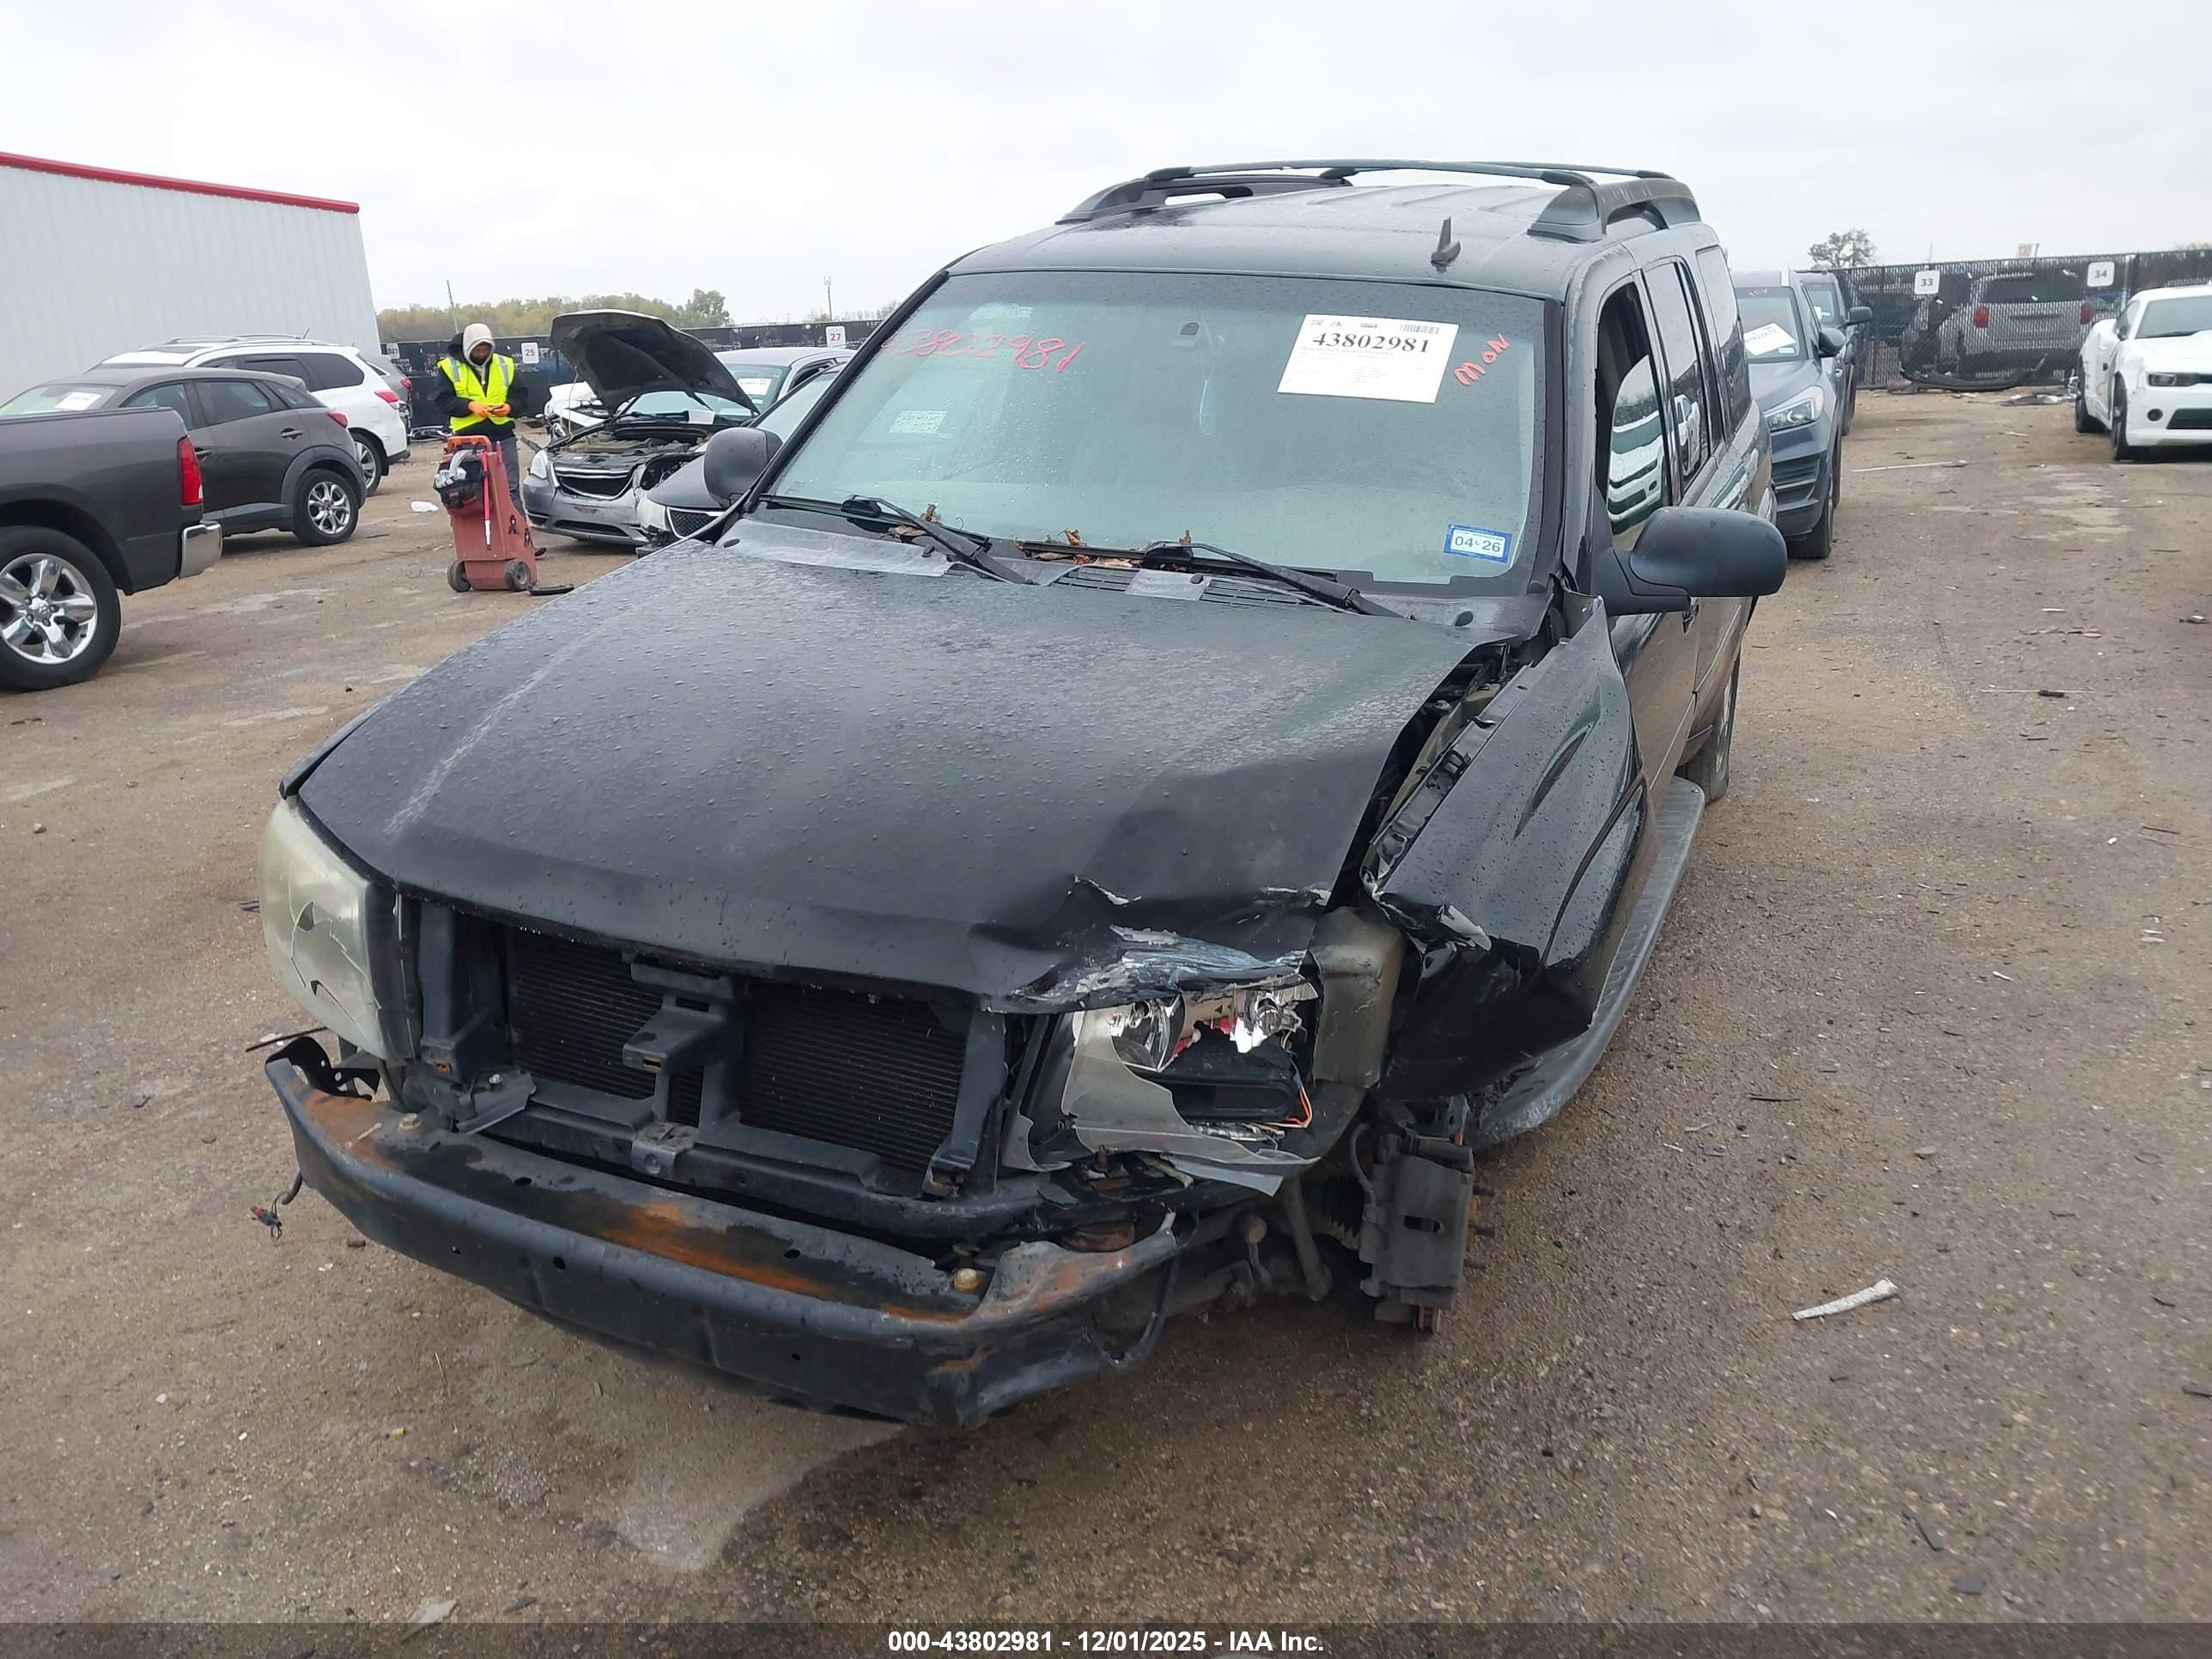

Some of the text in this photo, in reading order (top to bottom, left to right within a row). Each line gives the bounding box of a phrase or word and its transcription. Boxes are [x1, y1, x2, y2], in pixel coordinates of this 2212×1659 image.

[2094, 269, 2108, 279] 34
[1920, 277, 1934, 287] 33
[830, 332, 842, 342] 27
[1312, 331, 1431, 354] 43802981
[524, 348, 536, 357] 25
